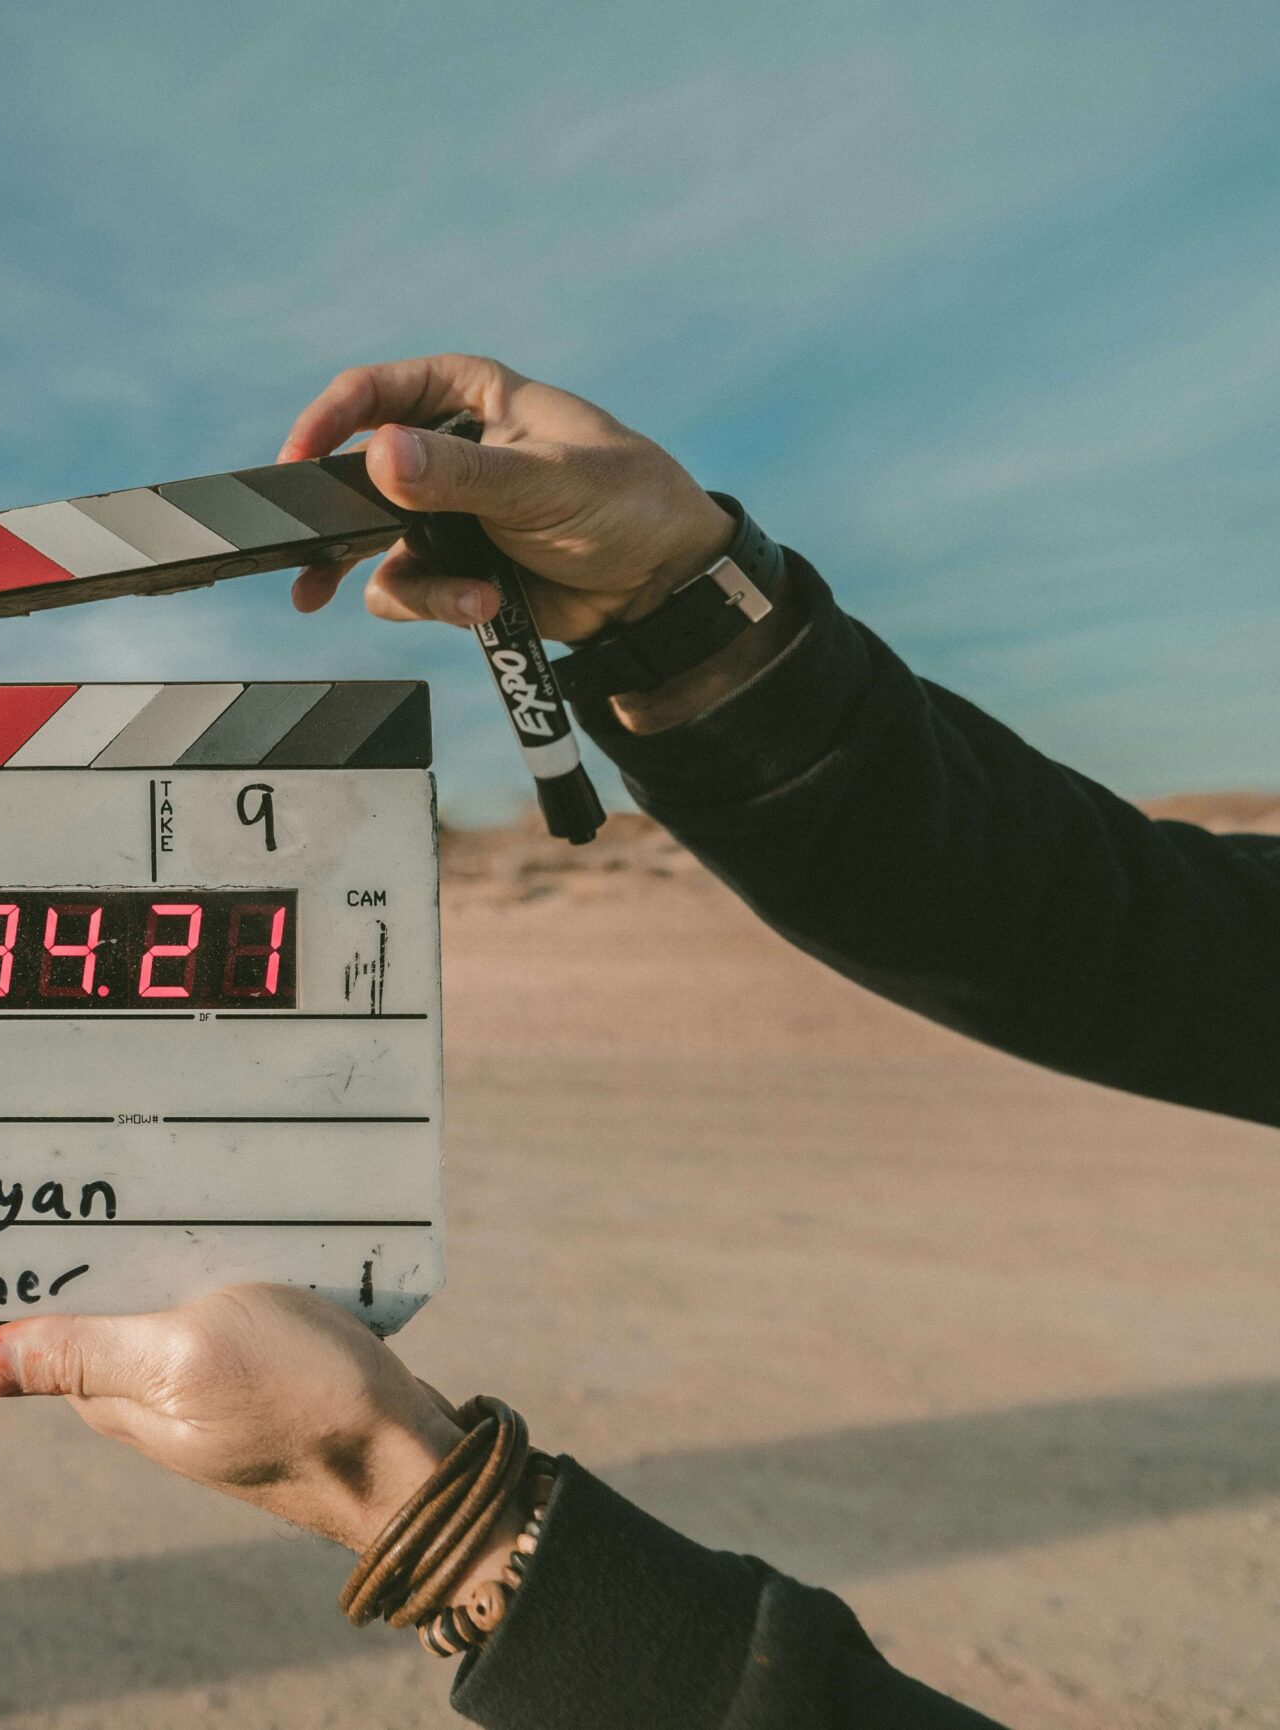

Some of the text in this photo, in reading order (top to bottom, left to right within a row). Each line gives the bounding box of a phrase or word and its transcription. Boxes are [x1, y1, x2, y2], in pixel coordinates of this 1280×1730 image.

[491, 649, 557, 738] EXPO
[527, 638, 554, 697] dry erase
[160, 780, 174, 853] TAKE
[236, 783, 277, 852] 9
[347, 890, 387, 907] CAM
[199, 1012, 212, 1022] DF
[117, 1113, 160, 1125] SHOW#
